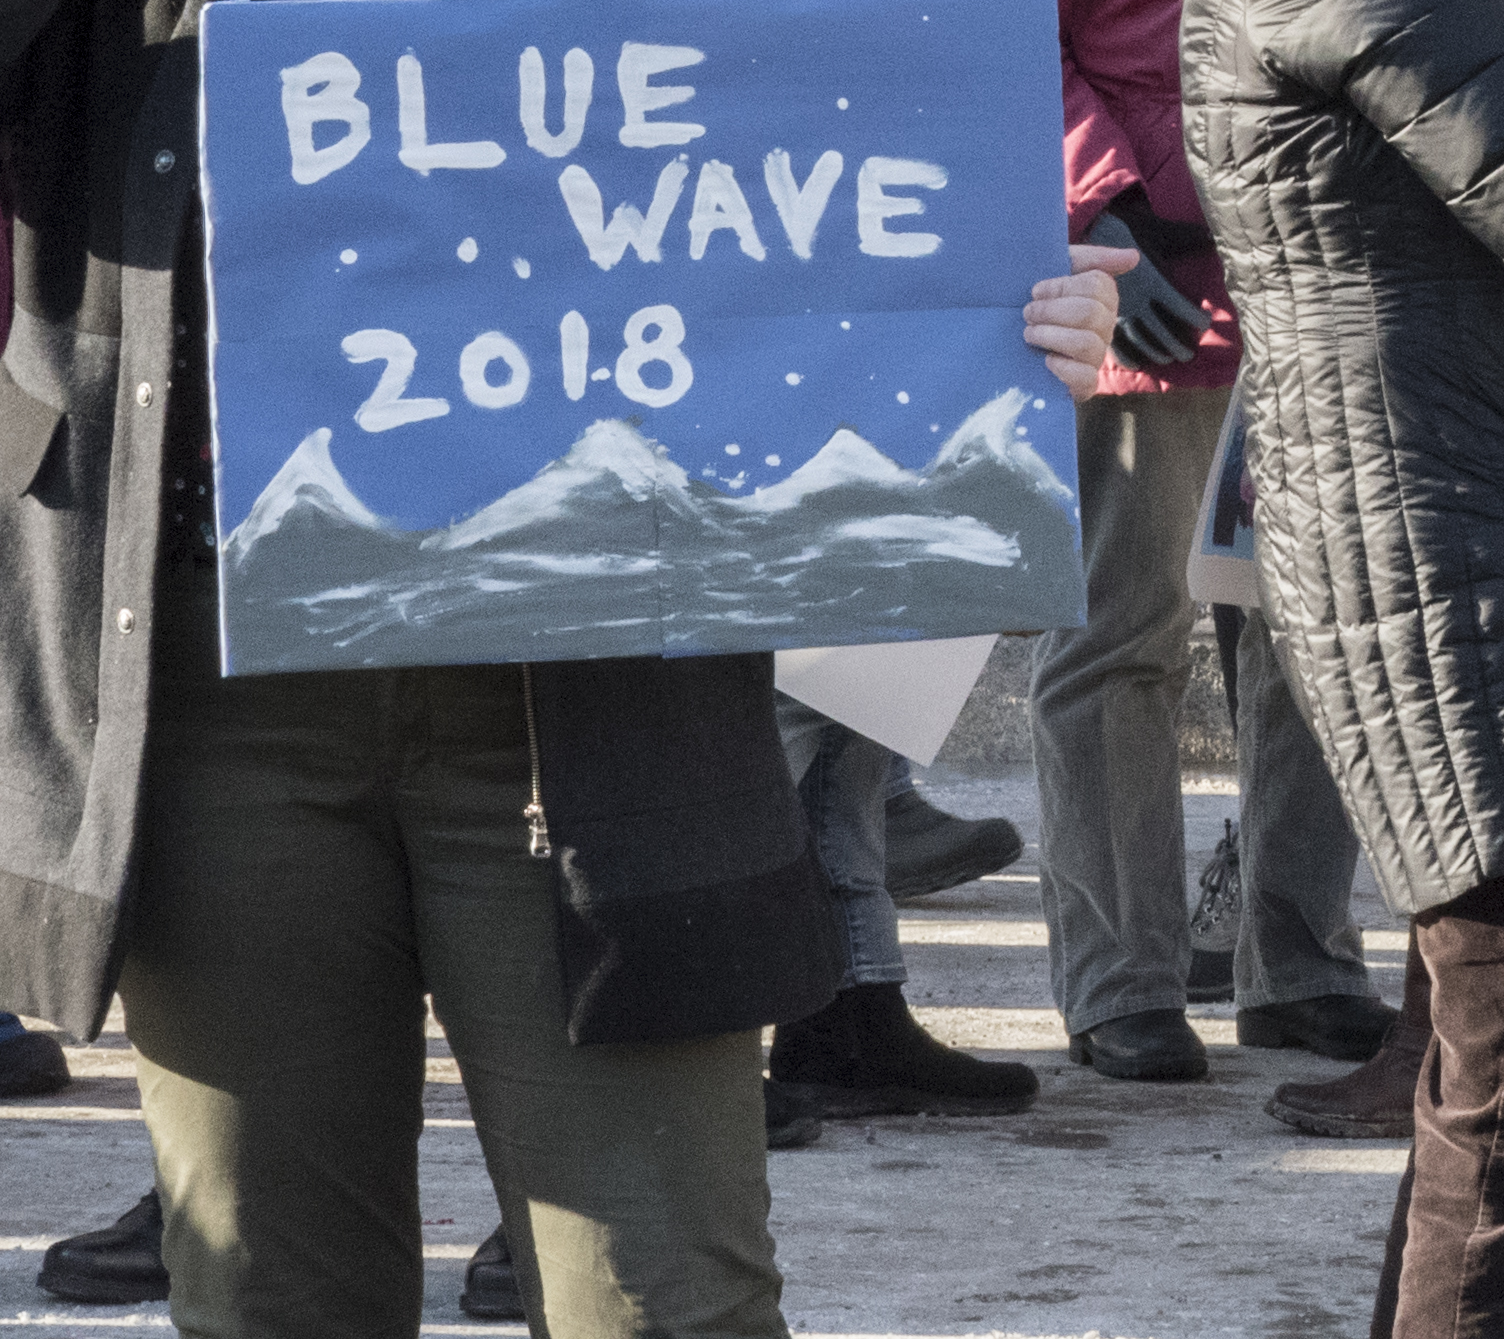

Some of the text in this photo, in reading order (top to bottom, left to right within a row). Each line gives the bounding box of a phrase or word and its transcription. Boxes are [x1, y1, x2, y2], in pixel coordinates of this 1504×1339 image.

[279, 40, 707, 185] BLUE
[557, 146, 949, 271] WAVE
[341, 302, 696, 432] 2018
